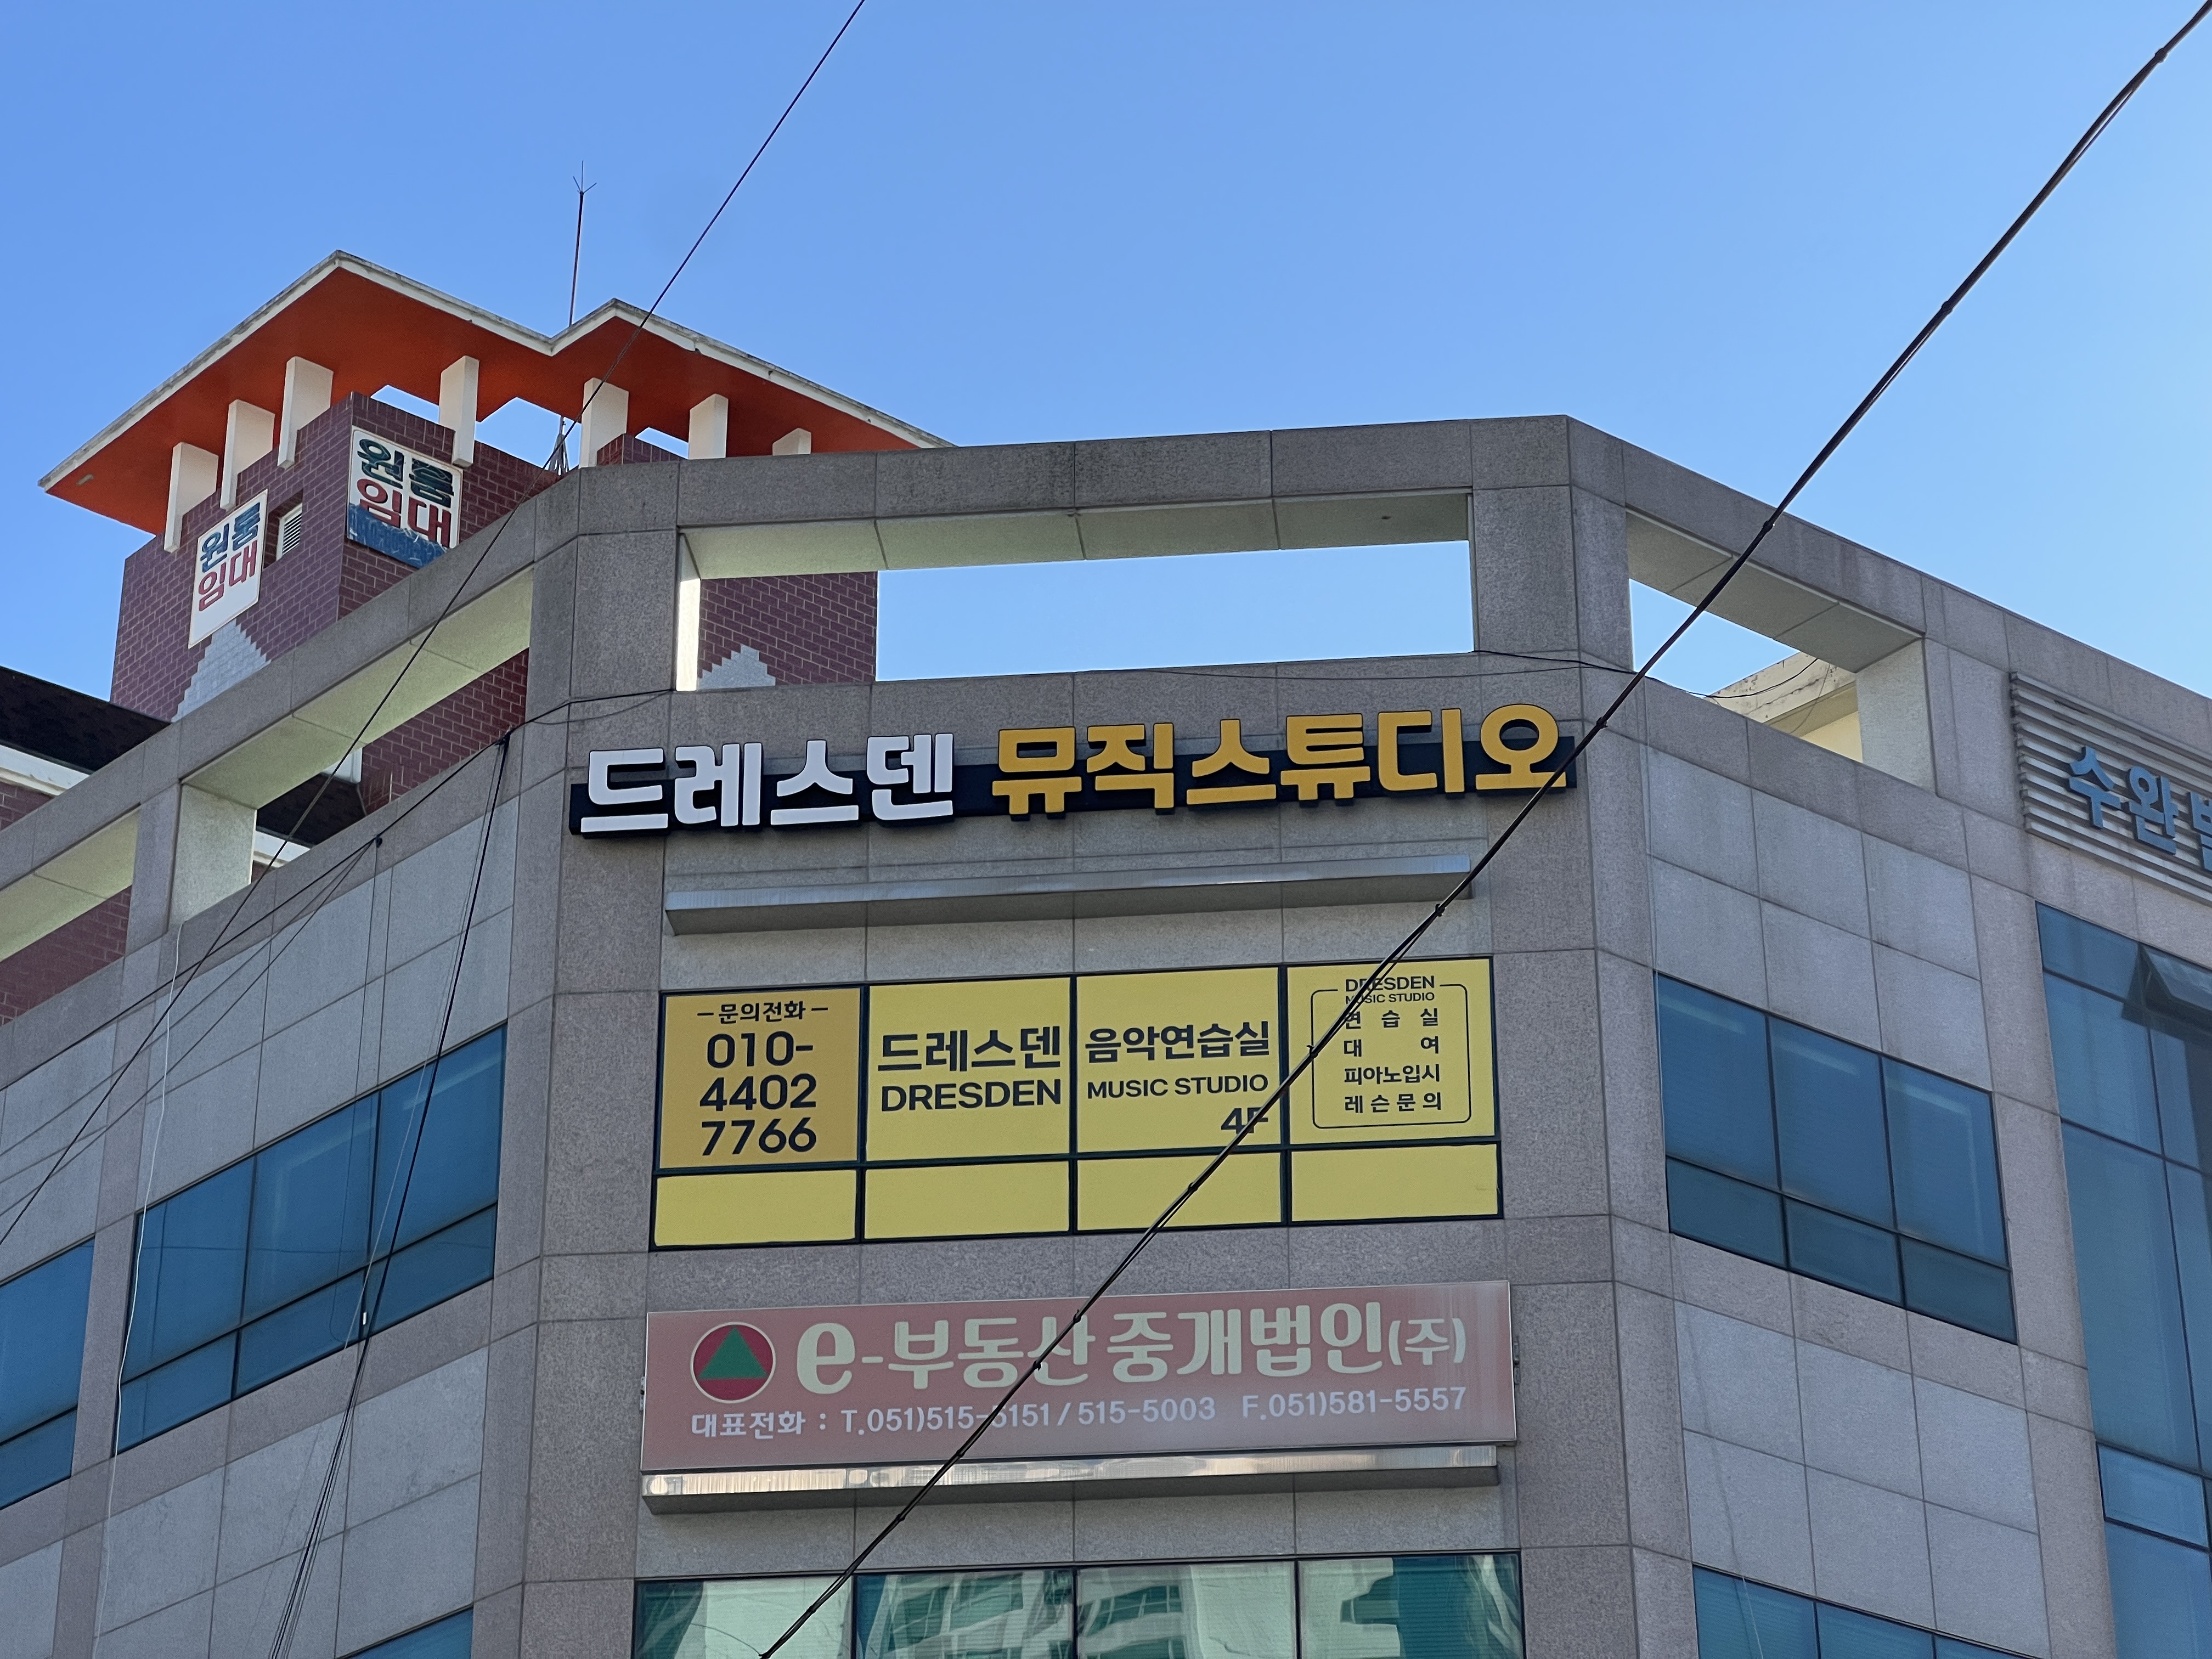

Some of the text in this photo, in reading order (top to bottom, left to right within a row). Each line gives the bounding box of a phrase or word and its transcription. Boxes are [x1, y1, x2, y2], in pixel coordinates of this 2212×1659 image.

[357, 478, 452, 548] 임대
[200, 502, 261, 573] 원룸
[198, 539, 258, 612] 임대
[580, 703, 1566, 833] 드레스덴 뮤직스튜디오
[718, 1000, 806, 1025] 문의전화
[1389, 992, 1435, 1003] STUDIO
[707, 1031, 814, 1069] 010-
[878, 1026, 1061, 1071] 드레스덴
[1085, 1021, 1269, 1063] 음악연습실
[699, 1073, 817, 1111] 4402
[1088, 1074, 1269, 1099] MUSIC STUDIO
[1344, 1064, 1440, 1086] 피아노입시
[882, 1079, 1061, 1111] DRESDEN
[701, 1117, 817, 1156] 7766
[691, 1409, 806, 1440] 대표전화
[1242, 1386, 1466, 1421] F.051)581-5557
